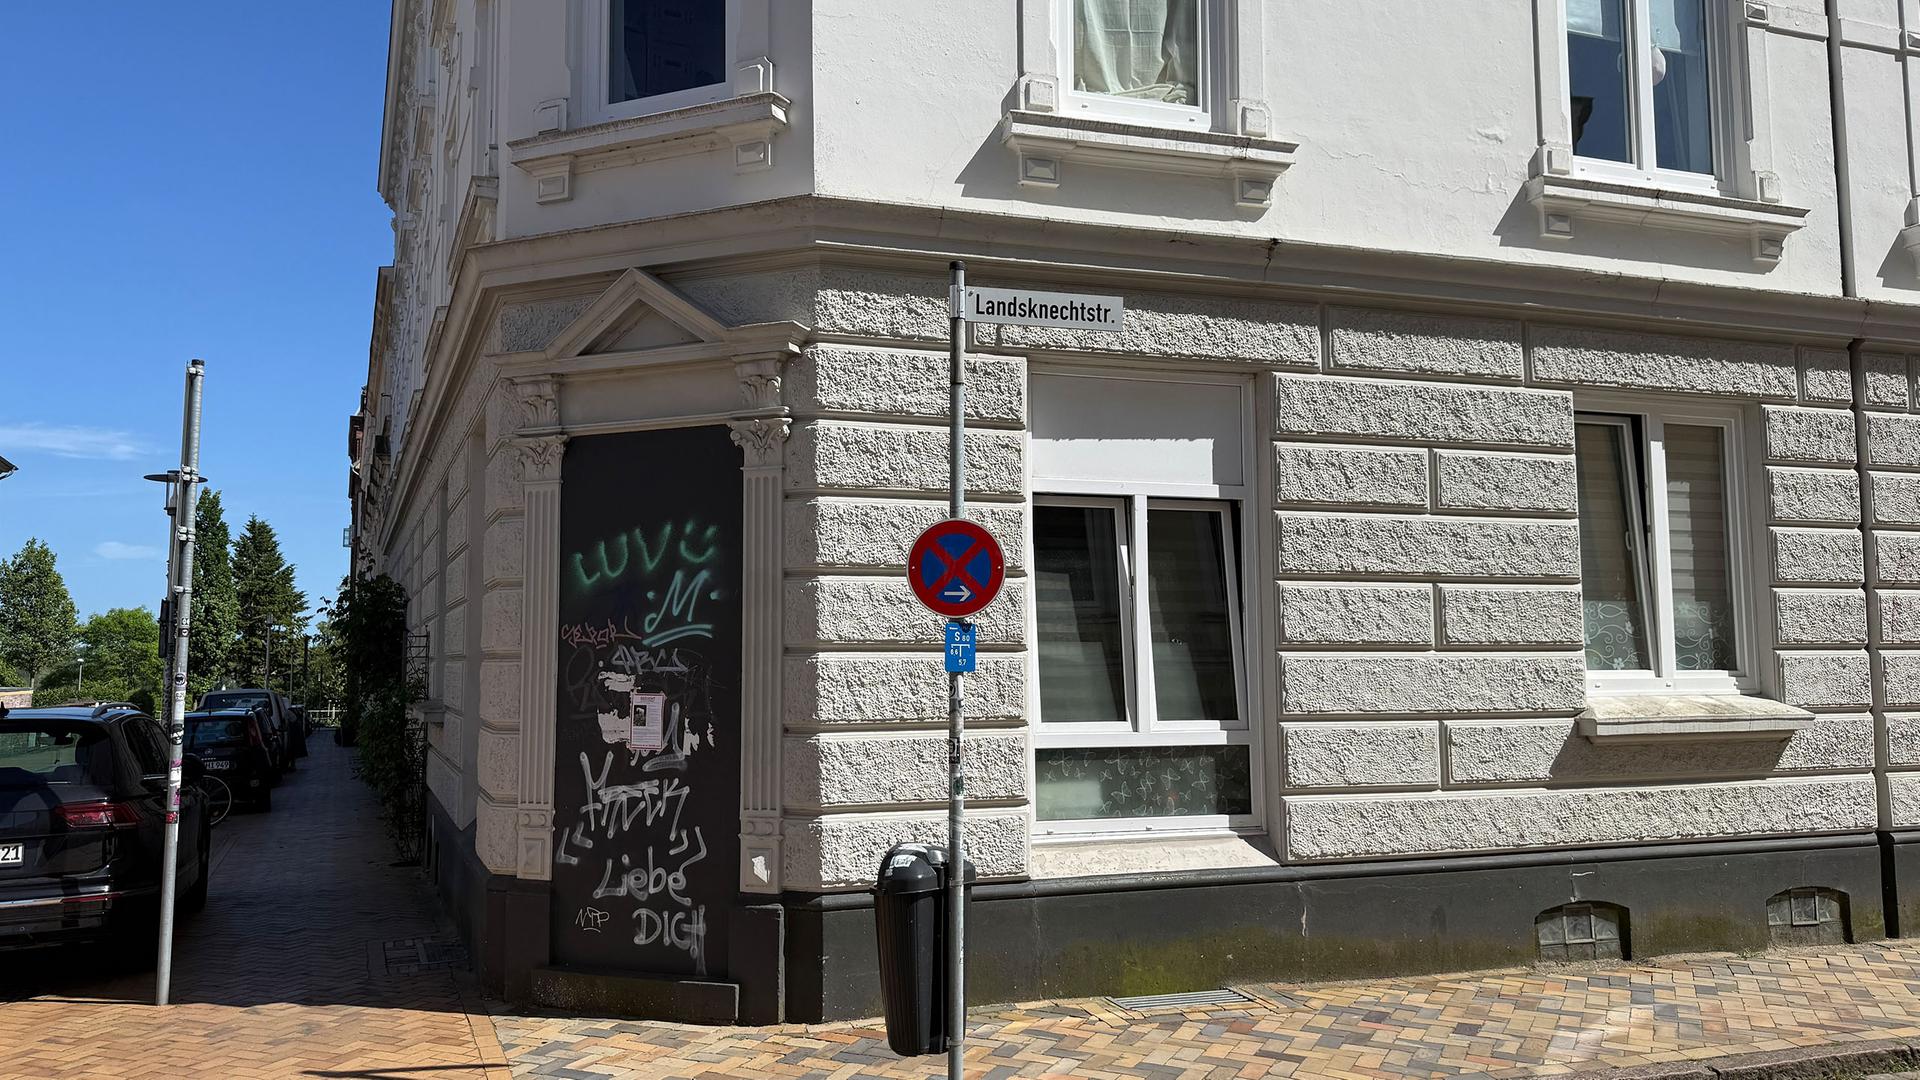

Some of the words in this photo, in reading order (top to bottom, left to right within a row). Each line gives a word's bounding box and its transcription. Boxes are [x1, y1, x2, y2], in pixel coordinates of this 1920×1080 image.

[975, 293, 1116, 324] Landsknechtstr.
[954, 631, 960, 641] S
[1, 846, 20, 861] 21
[592, 846, 692, 906] Liebe
